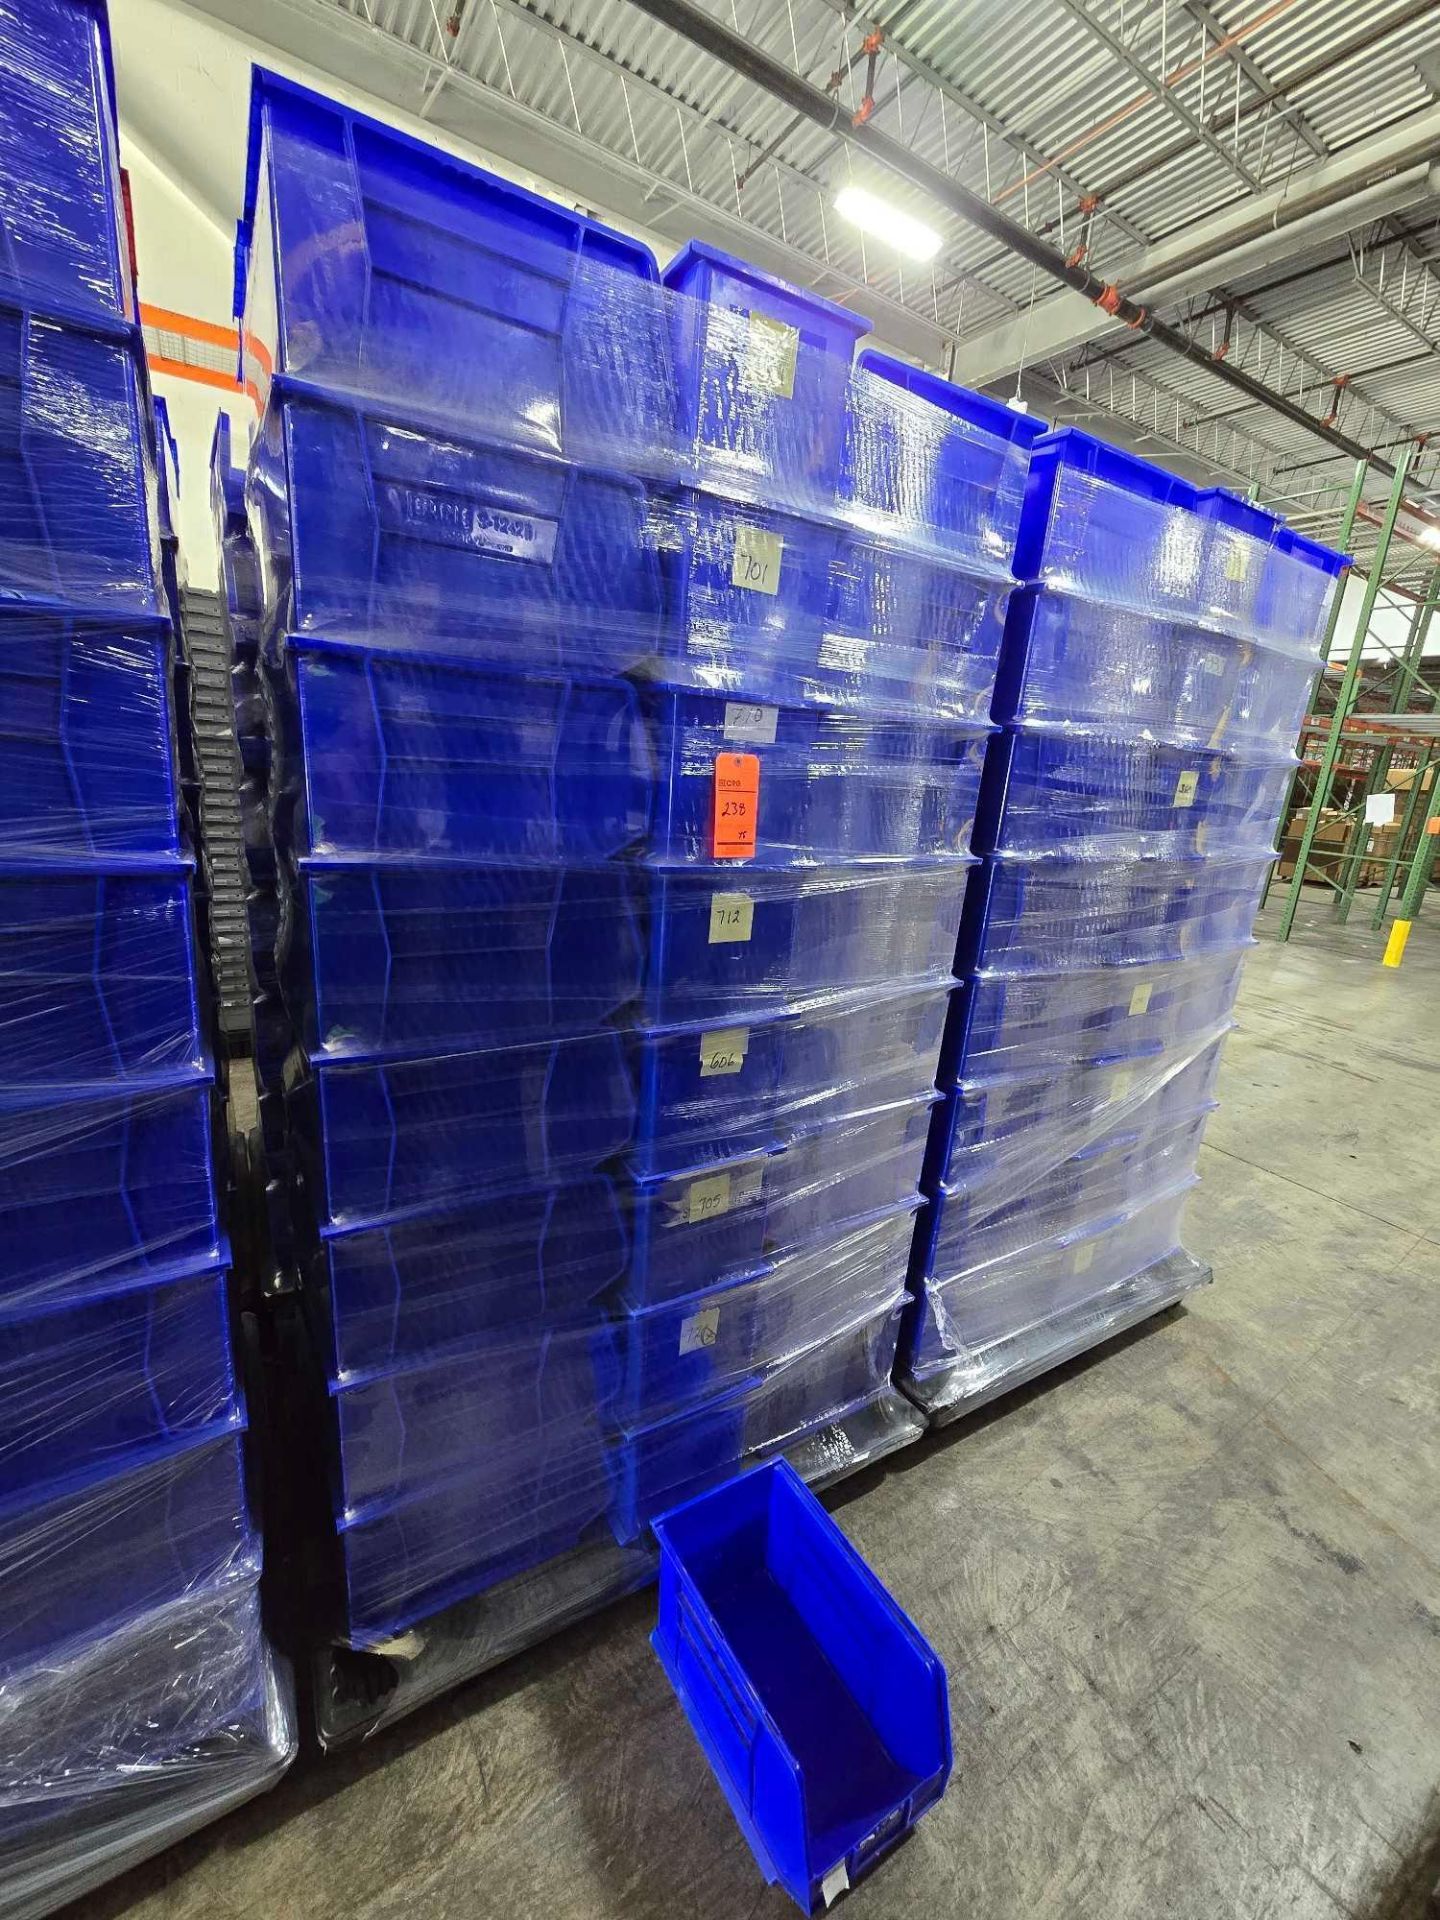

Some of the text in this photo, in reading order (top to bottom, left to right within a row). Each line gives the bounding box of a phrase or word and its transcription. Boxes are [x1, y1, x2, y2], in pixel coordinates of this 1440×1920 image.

[740, 553, 768, 584] 701
[721, 802, 746, 817] 238
[715, 909, 740, 925] 712
[699, 1193, 721, 1214] 705
